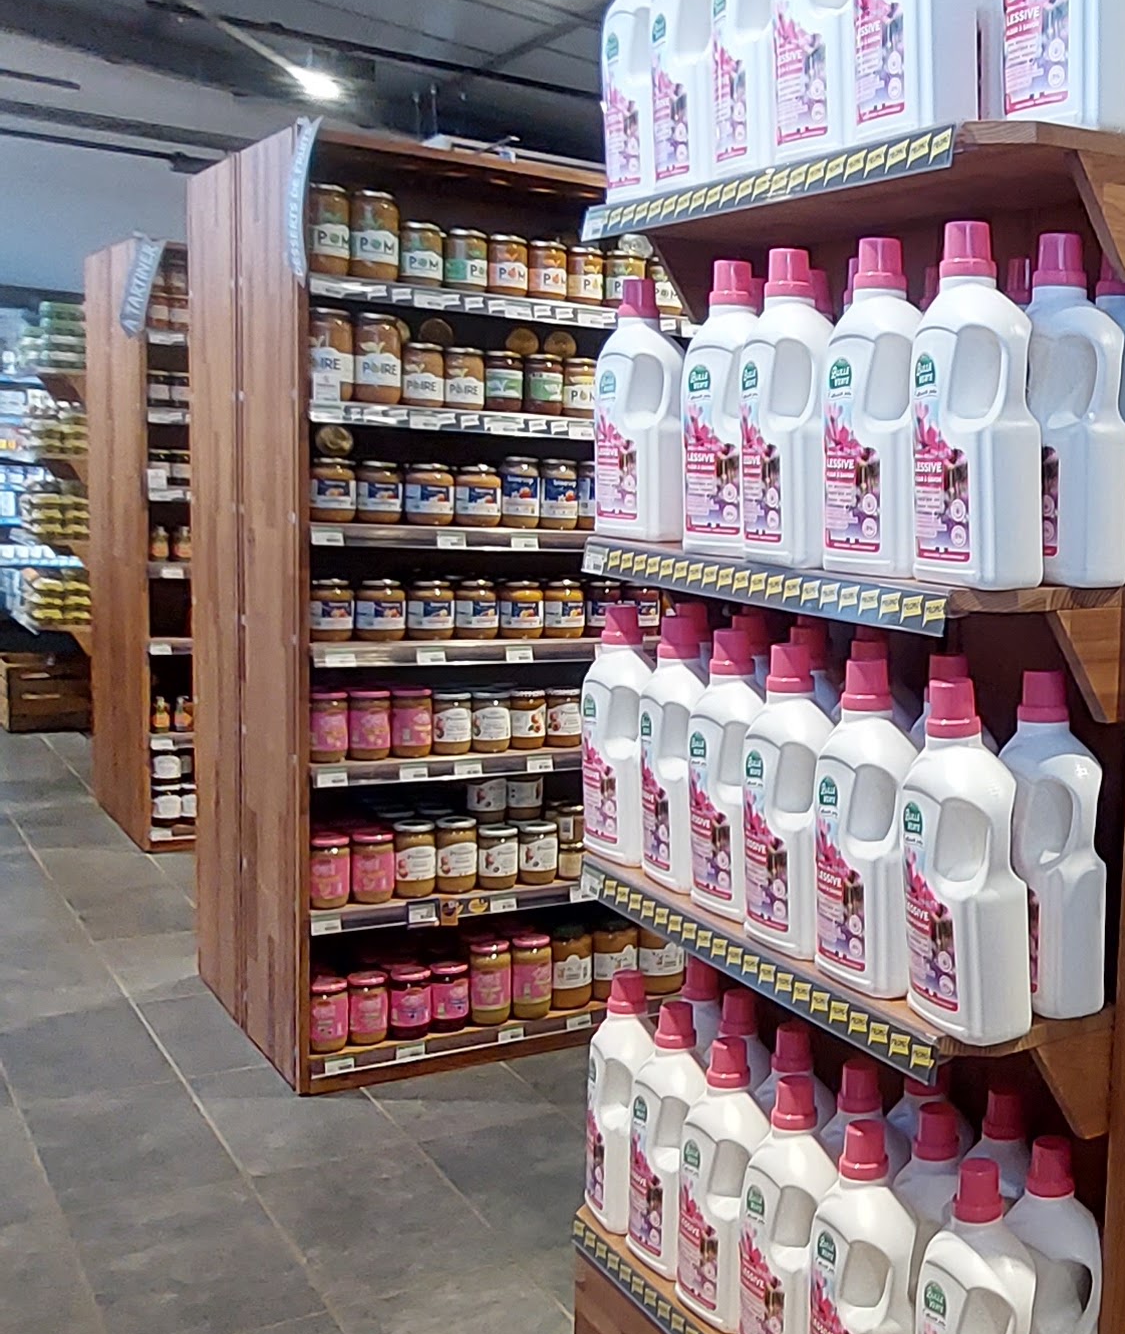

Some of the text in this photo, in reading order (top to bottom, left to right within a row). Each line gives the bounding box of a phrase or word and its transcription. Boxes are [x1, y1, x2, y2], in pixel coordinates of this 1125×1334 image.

[1006, 6, 1040, 26] LESSIVE
[126, 245, 159, 315] TARTINER
[687, 452, 714, 463] LESSIVE
[827, 458, 854, 469] LESSIVE
[915, 462, 942, 473] LESSIVE
